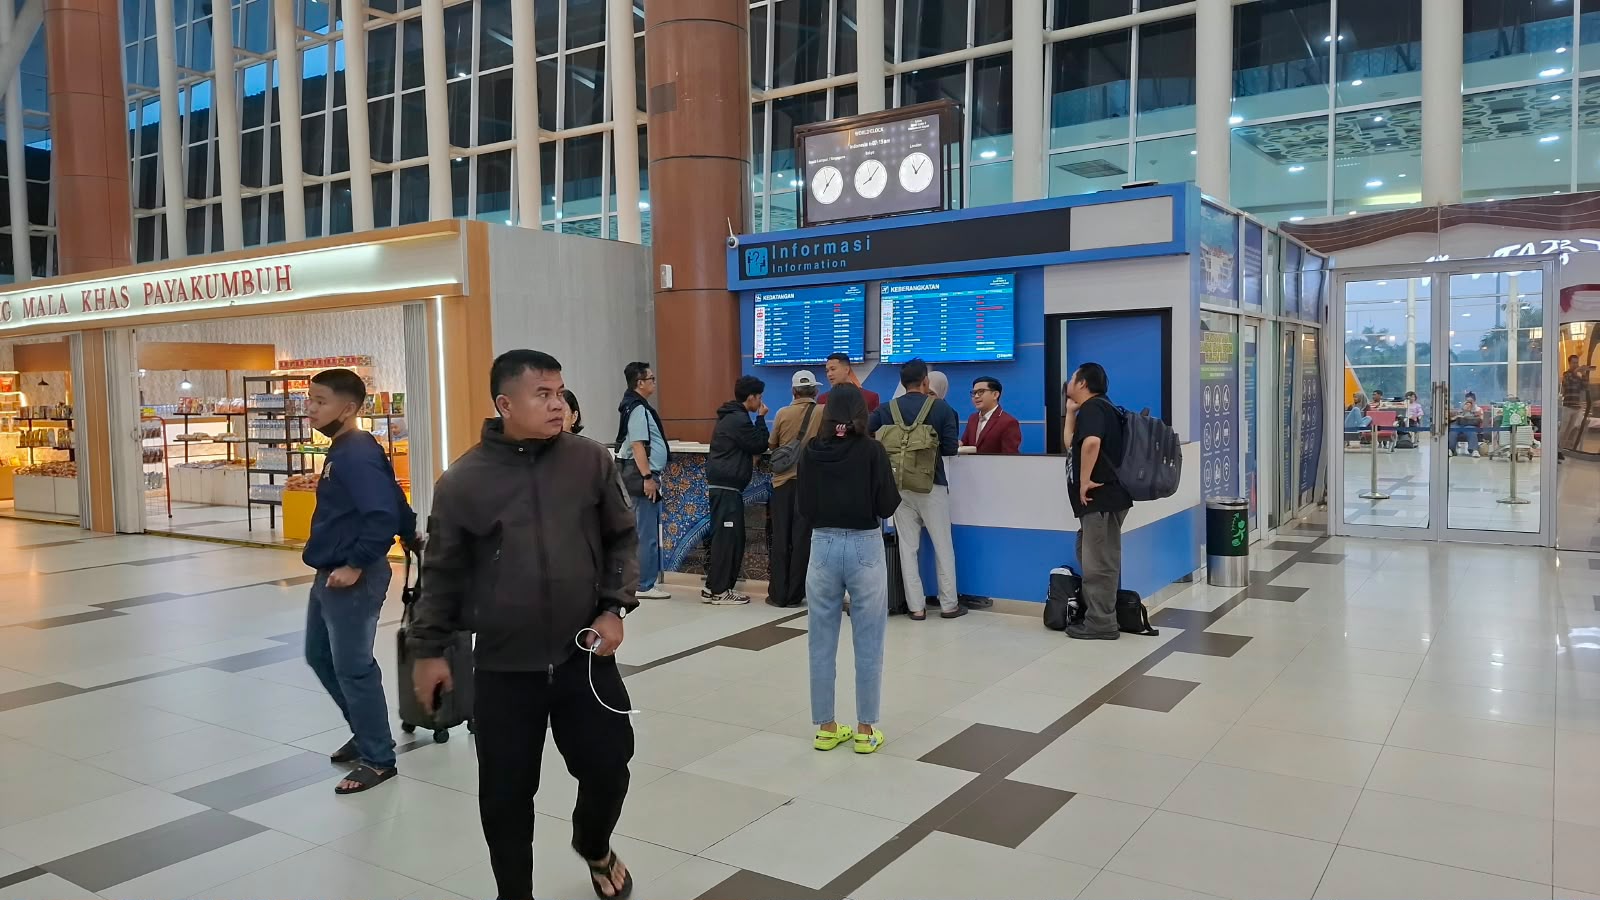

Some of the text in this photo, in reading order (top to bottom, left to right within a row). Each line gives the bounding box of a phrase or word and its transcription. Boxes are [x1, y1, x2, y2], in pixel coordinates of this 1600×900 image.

[772, 235, 870, 259] Informasi
[772, 259, 846, 273] Information
[22, 293, 68, 319] MALA
[81, 286, 129, 313] KHAS
[143, 265, 292, 306] PAYAKUMBUH
[890, 283, 940, 293] KEBERANGKATAN
[762, 292, 795, 301] KEDATANGAN
